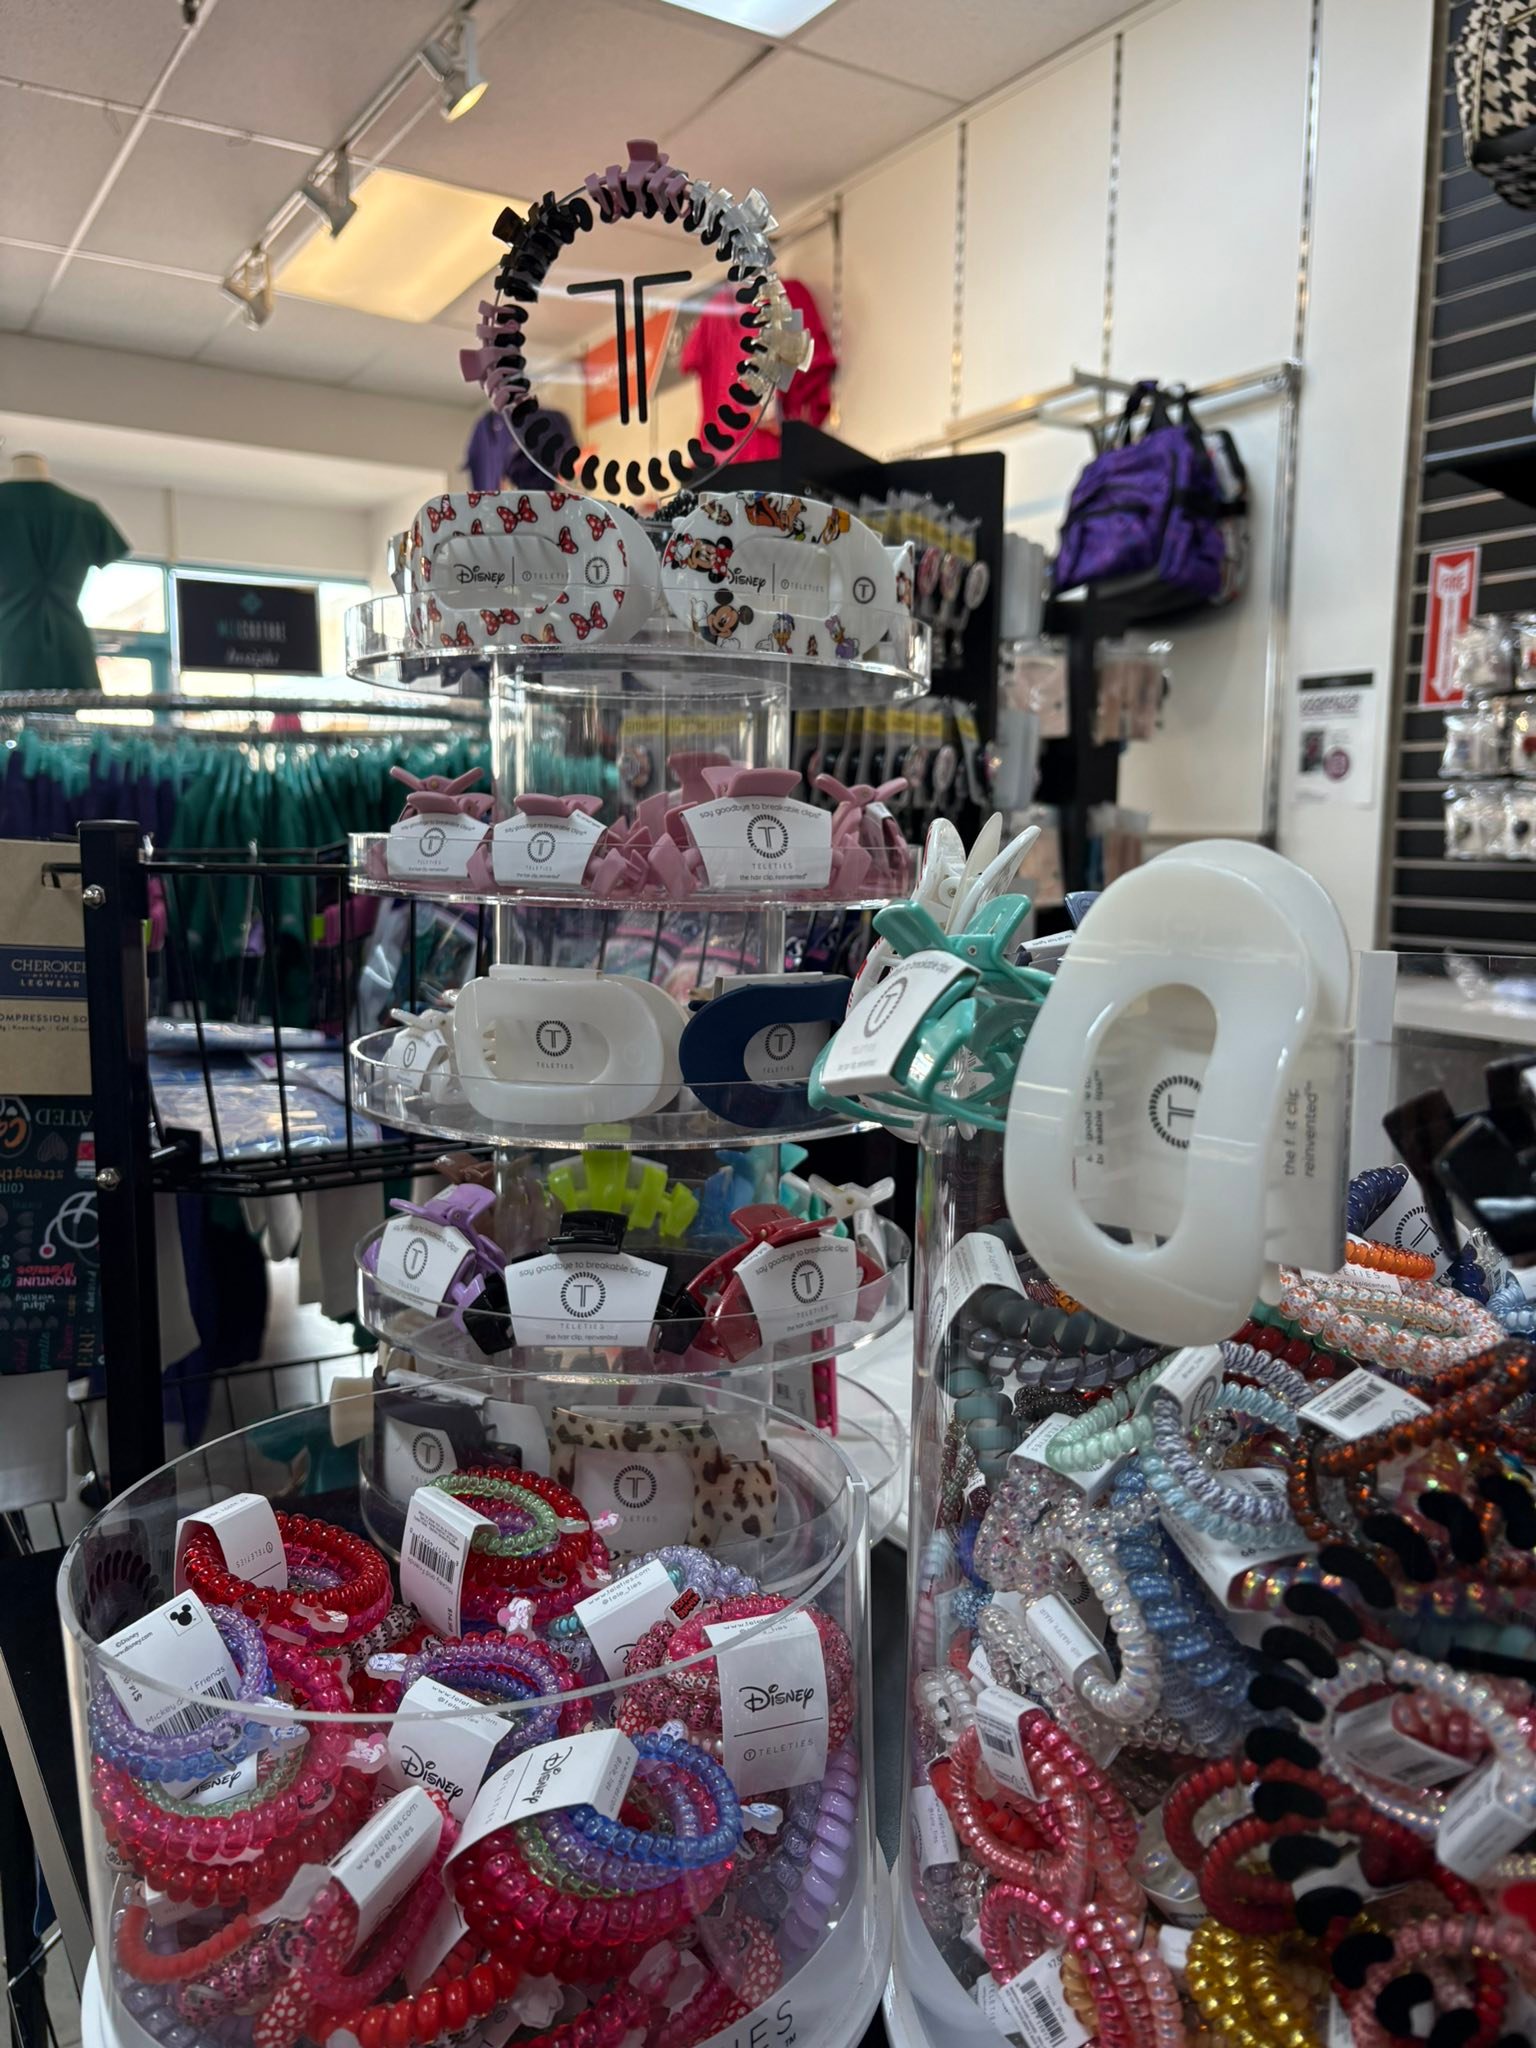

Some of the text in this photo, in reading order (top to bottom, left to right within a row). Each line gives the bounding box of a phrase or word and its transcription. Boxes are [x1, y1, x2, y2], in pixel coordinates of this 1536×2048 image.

[700, 810, 714, 819] say
[715, 803, 750, 815] goodbye
[761, 803, 800, 814] breakable
[20, 979, 80, 988] LEGWEAR
[519, 1268, 535, 1278] say
[536, 1261, 574, 1274] goodbye
[575, 1261, 585, 1269] to
[586, 1261, 629, 1273] breakable
[755, 1265, 769, 1276] say
[768, 1252, 796, 1271] goodbye
[560, 1322, 605, 1330] TELETIES
[236, 1547, 266, 1568] TELETIES
[145, 1703, 177, 1725] Mickey
[194, 1665, 226, 1690] Friends
[759, 1737, 815, 1757] TELETIES
